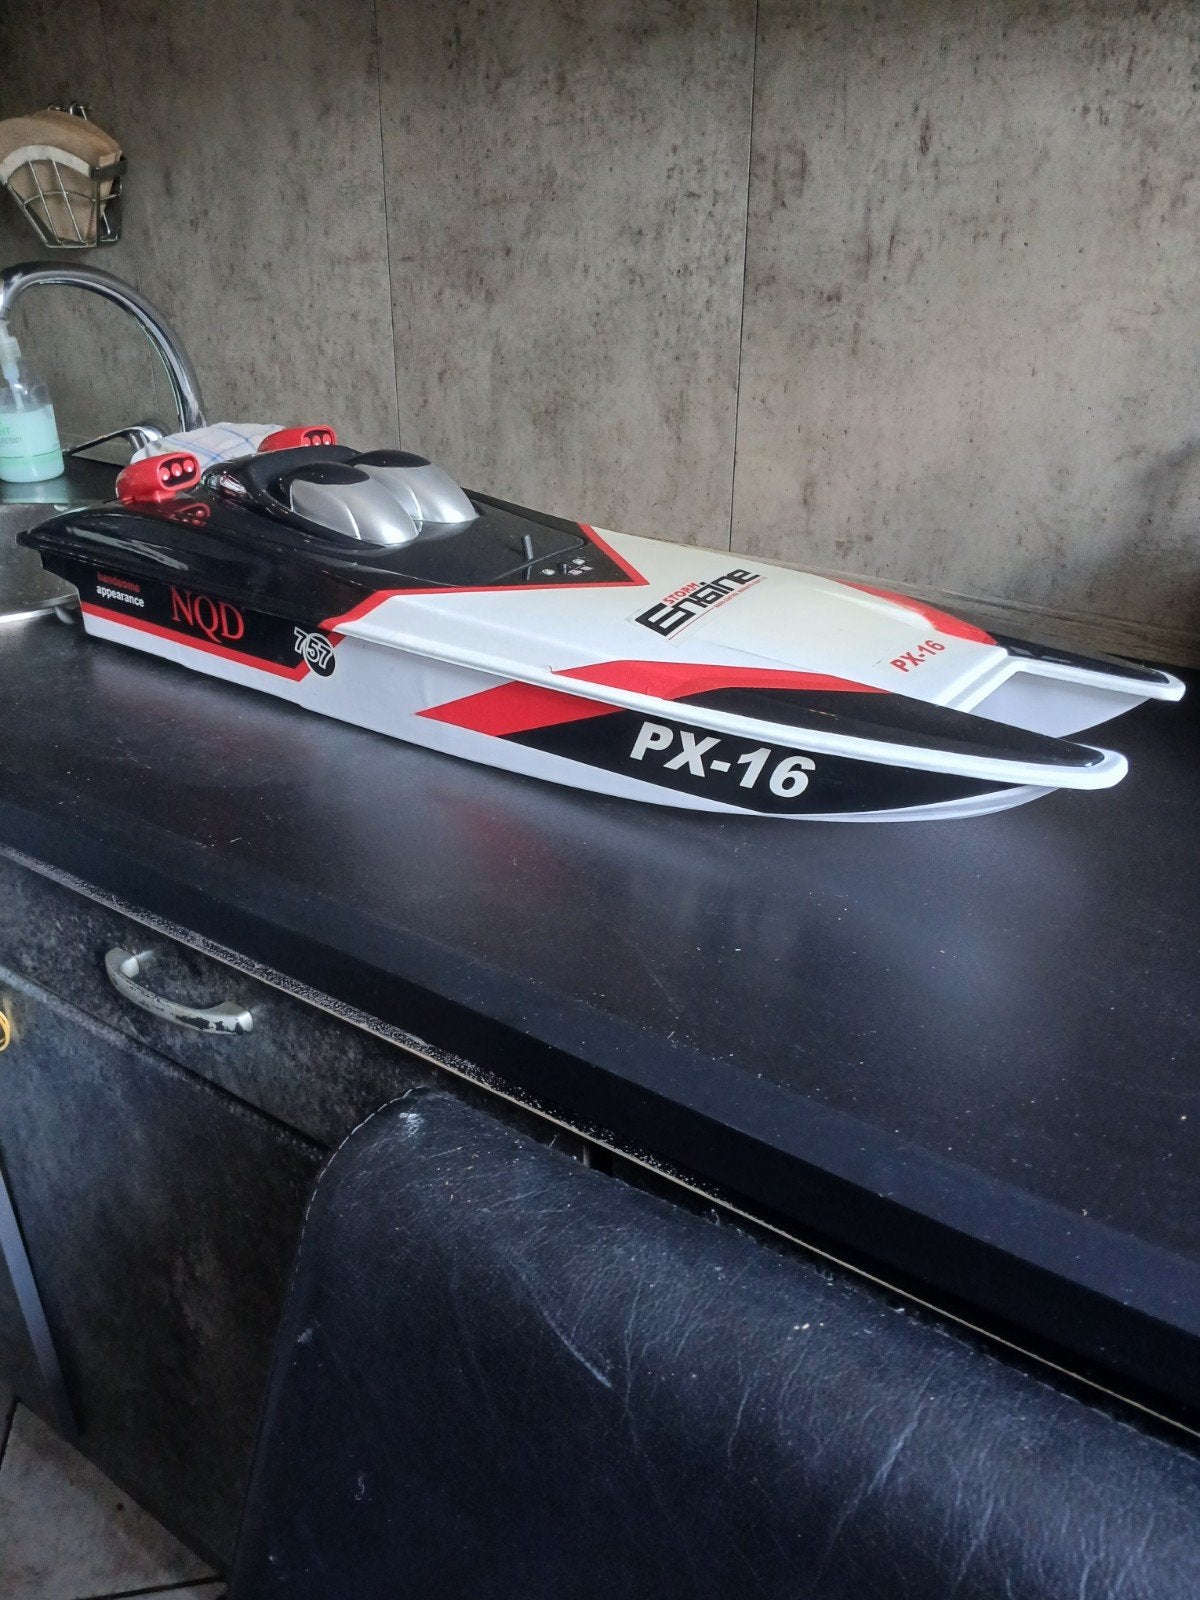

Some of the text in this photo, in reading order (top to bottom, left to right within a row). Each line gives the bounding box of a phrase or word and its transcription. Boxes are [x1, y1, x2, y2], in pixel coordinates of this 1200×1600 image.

[96, 585, 145, 608] appearance
[662, 582, 700, 605] STORM
[169, 584, 246, 644] NQD
[889, 639, 946, 673] PX-16
[630, 721, 817, 799] PX-16
